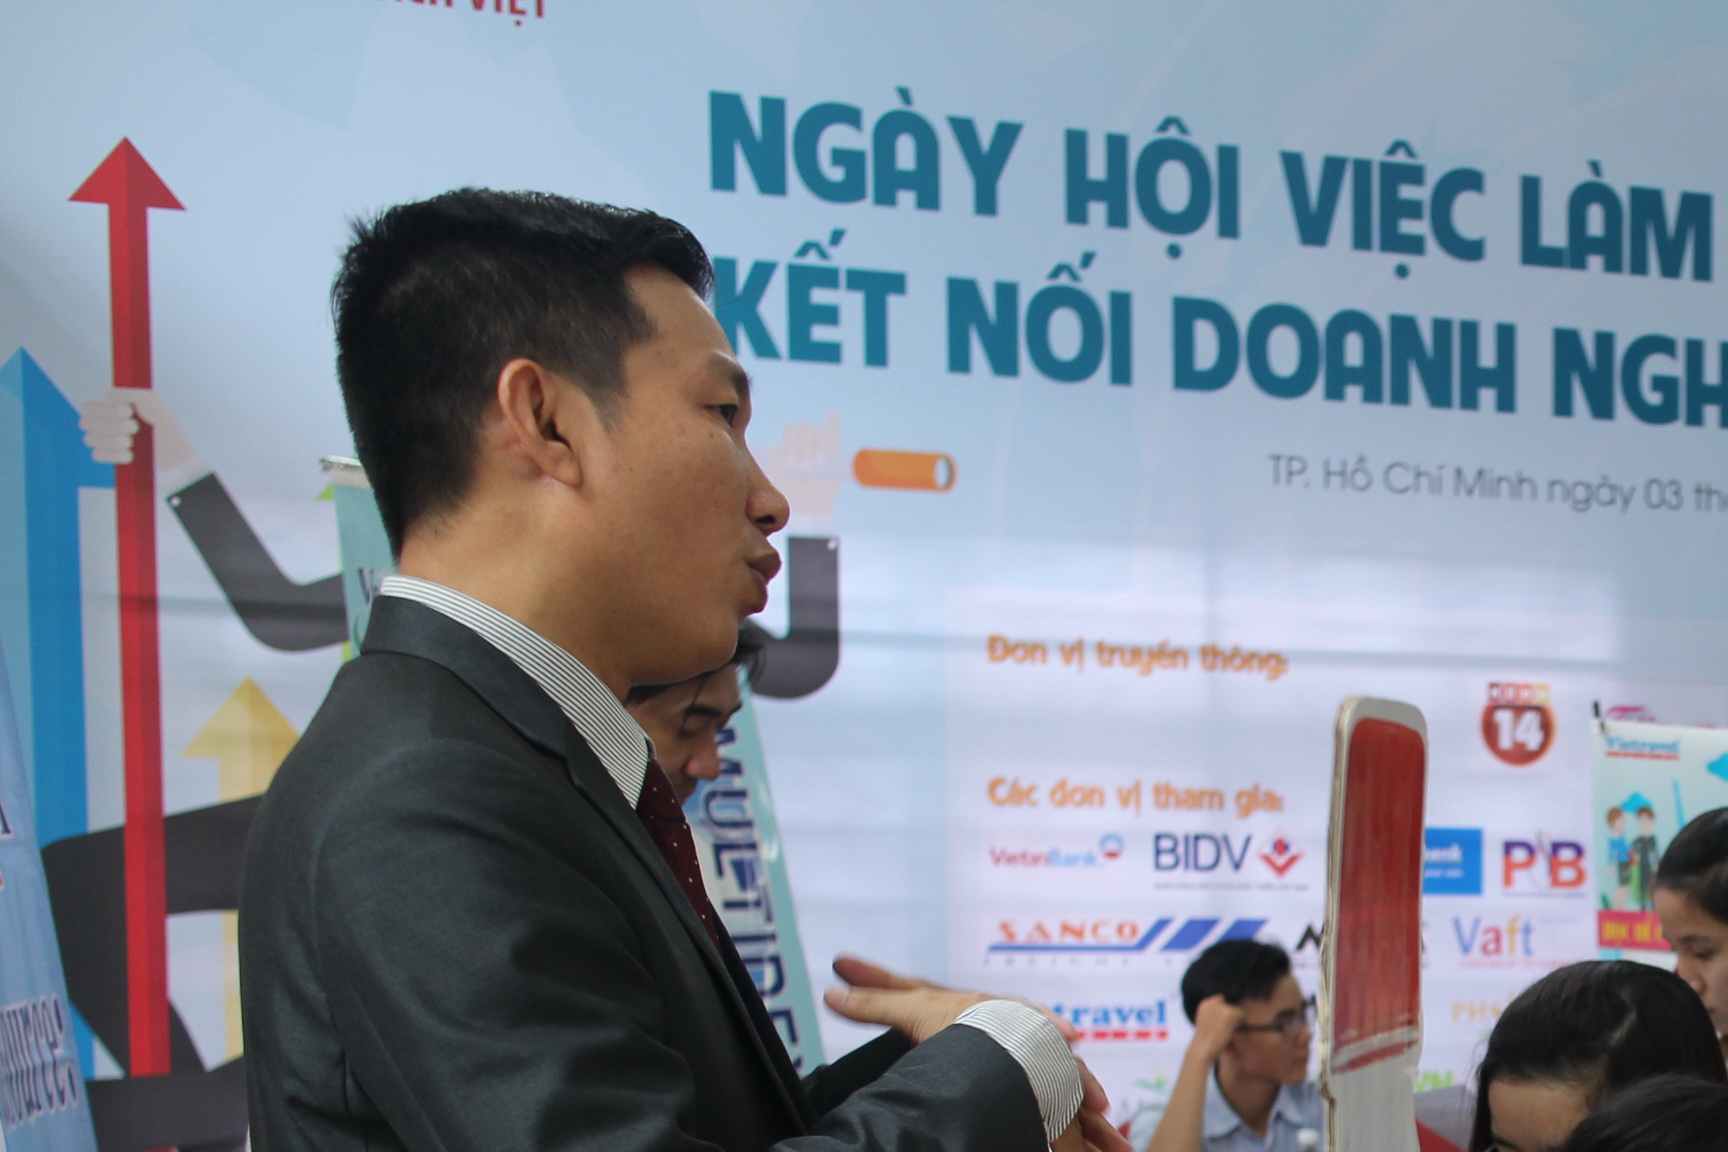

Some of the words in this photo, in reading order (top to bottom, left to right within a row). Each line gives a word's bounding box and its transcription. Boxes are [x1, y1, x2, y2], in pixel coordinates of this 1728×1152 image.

[708, 86, 1024, 217] NGÀY
[1064, 116, 1239, 260] HỘI
[1279, 139, 1486, 279] VIỆC
[1520, 160, 1714, 283] LÀM
[714, 228, 906, 368] KẾT
[946, 252, 1133, 386] NỐI
[1173, 296, 1516, 414] DOANH
[1268, 453, 1311, 489] TP.
[1383, 462, 1446, 496] Chí
[1453, 466, 1538, 500] Minh
[1548, 475, 1637, 514] ngày
[1644, 478, 1684, 511] 03
[1060, 637, 1085, 674] vị
[1493, 708, 1545, 752] 14
[1117, 780, 1142, 817] vị
[1152, 782, 1225, 811] tham
[1153, 833, 1251, 873] BIDV
[999, 919, 1140, 943] SANCO
[1453, 914, 1534, 956] Vaft
